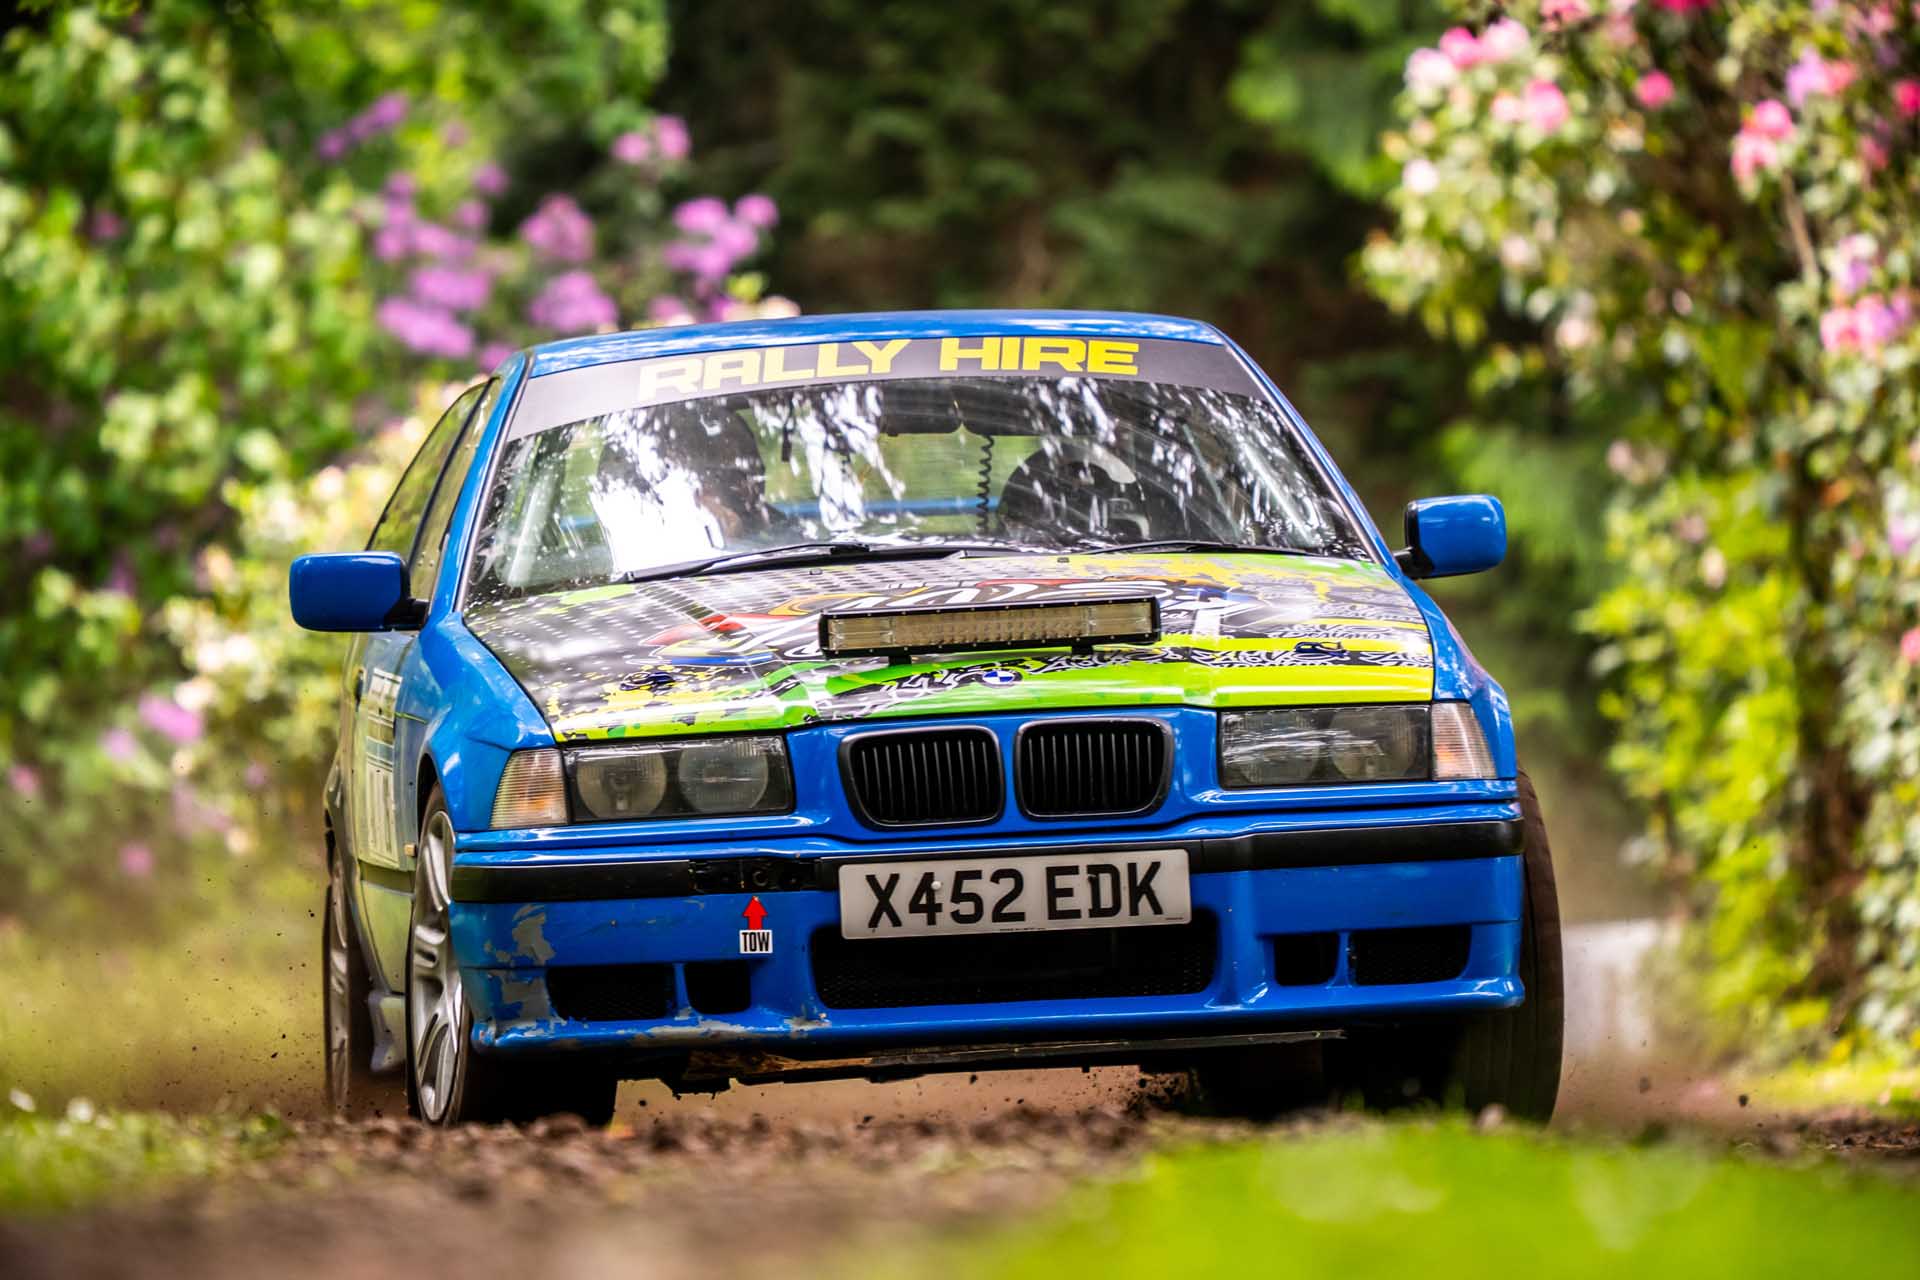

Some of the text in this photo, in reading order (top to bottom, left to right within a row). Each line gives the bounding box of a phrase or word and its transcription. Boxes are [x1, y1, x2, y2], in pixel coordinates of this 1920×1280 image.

[639, 336, 1139, 407] RALLY HIRE
[865, 861, 1163, 929] X452 EDK
[741, 931, 770, 952] TOW
